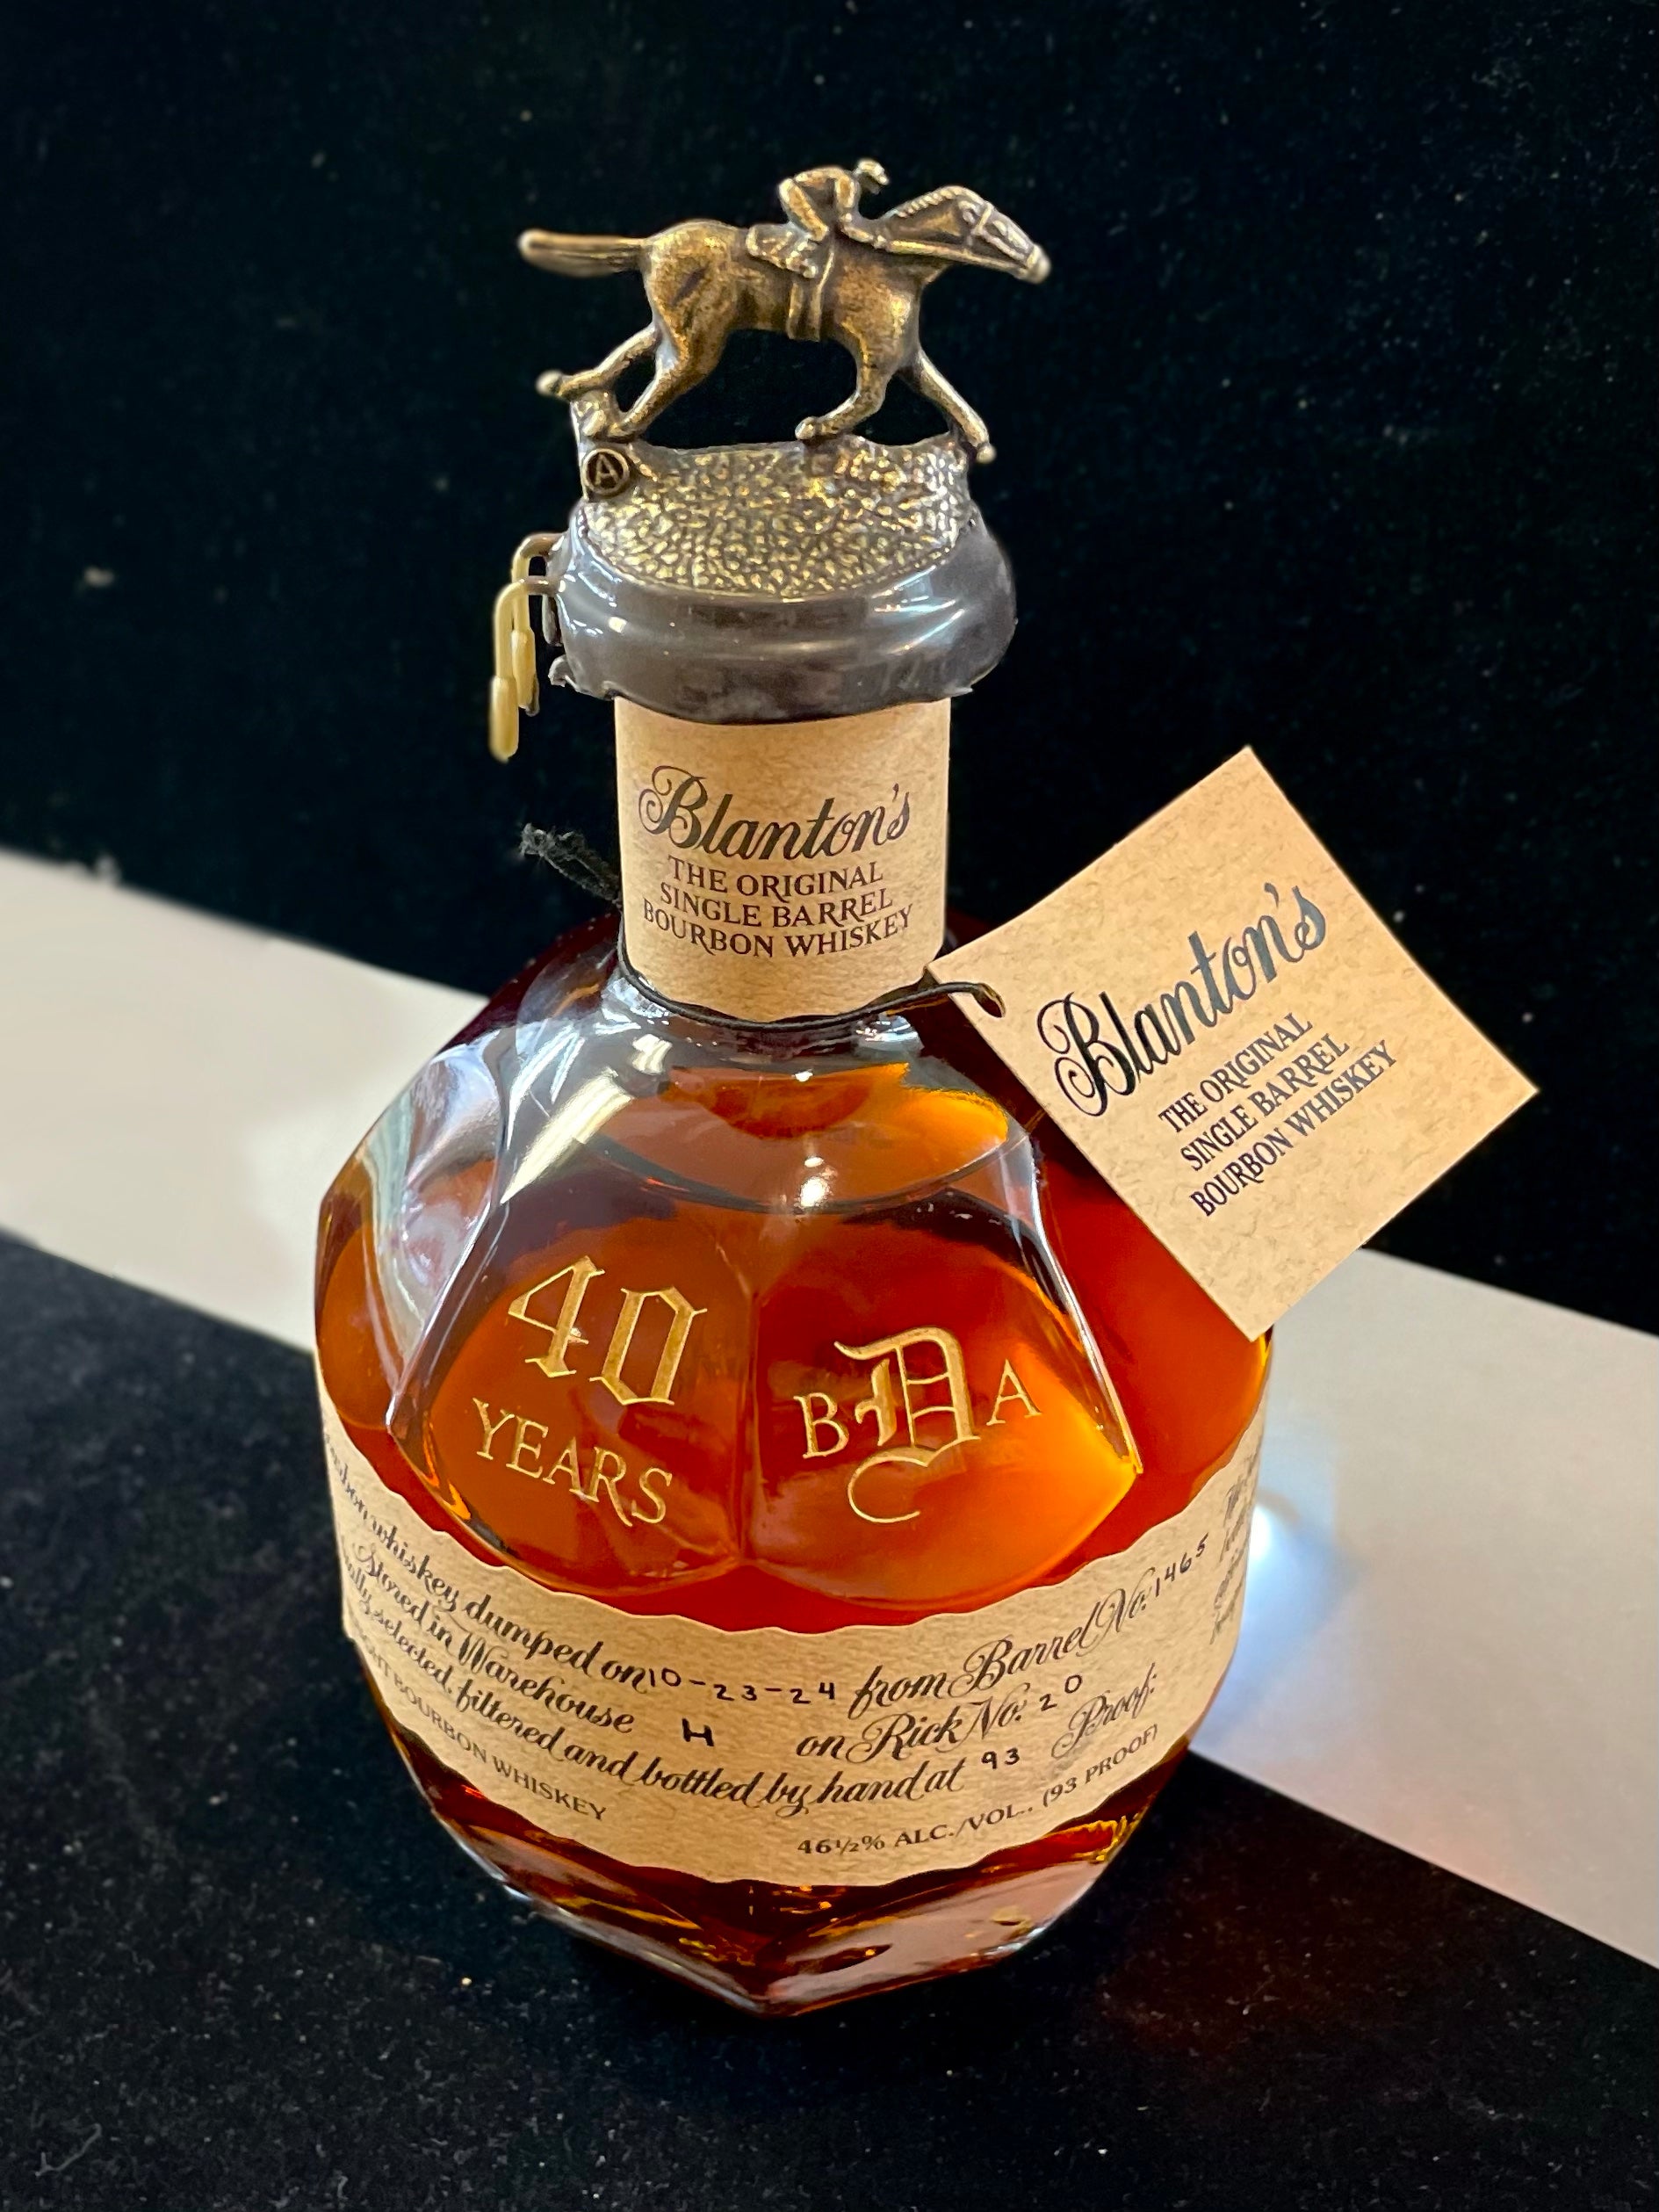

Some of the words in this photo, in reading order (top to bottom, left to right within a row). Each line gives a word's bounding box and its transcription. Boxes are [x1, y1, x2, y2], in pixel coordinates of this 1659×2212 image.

[638, 765, 910, 859] Blanton's
[643, 898, 774, 958] BOURBON
[784, 903, 913, 957] WHISKEY
[660, 882, 762, 928] SINGLE
[772, 888, 893, 928] BARREL
[668, 855, 727, 893] THE
[737, 862, 884, 902] ORIGINAL
[1037, 882, 1326, 1117] Blanton's
[1158, 1092, 1208, 1132] THE
[1200, 1012, 1313, 1103] ORIGINAL
[1180, 1104, 1259, 1171] SINGLE
[1248, 1033, 1350, 1117] BARREL
[1190, 1127, 1294, 1217] BOURBON
[1284, 1039, 1396, 1137] WHISKEY
[508, 1255, 707, 1406] 40
[472, 1398, 673, 1527] YEARS
[371, 1515, 459, 1613] whiskey
[465, 1594, 603, 1676] dumped
[601, 1660, 647, 1694] on
[848, 1665, 949, 1720] from
[948, 1601, 1100, 1698] Barrel
[1155, 1532, 1209, 1597] 1465
[427, 1615, 455, 1653] in
[436, 1608, 634, 1734] Warehouse
[682, 1717, 714, 1747] H
[846, 1706, 963, 1764] Rick
[1040, 1674, 1083, 1711] 20
[394, 1673, 487, 1763] BOURBON
[492, 1755, 606, 1820] WHISKEY
[456, 1679, 565, 1761] filtered
[564, 1745, 638, 1786] and
[636, 1757, 764, 1808] bottled
[761, 1772, 811, 1818] by
[811, 1760, 929, 1804] hand
[925, 1757, 967, 1793] at
[981, 1747, 1020, 1769] 93
[796, 1735, 847, 1760] on
[1043, 1777, 1077, 1807] (93
[1086, 1724, 1158, 1784] PROOF)
